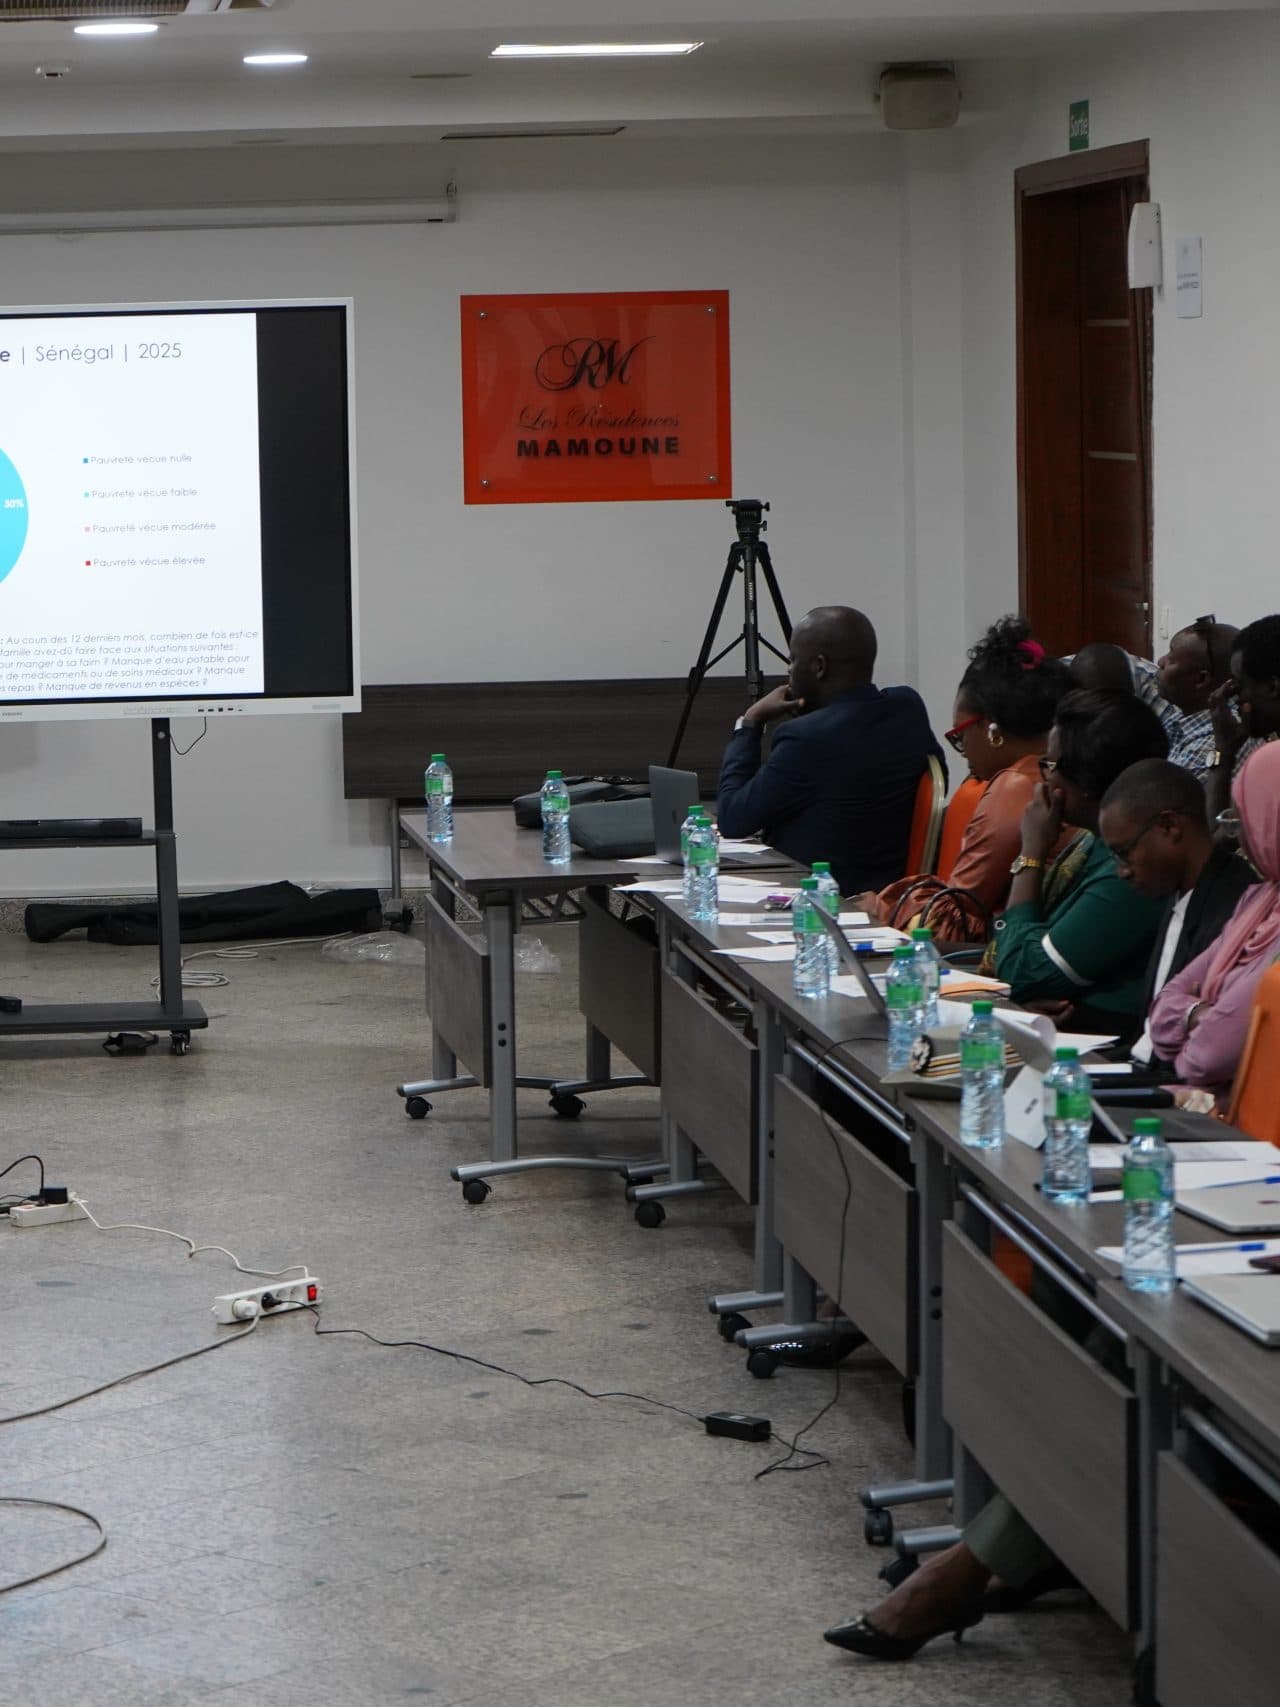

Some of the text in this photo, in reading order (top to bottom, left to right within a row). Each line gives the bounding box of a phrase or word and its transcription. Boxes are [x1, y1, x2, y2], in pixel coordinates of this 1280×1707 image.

[35, 344, 114, 364] Sénégal
[138, 343, 183, 359] 2025
[536, 335, 657, 391] RM
[517, 437, 679, 457] MAMOUNE
[7, 637, 20, 645] Au
[22, 637, 47, 645] cours
[50, 635, 67, 643] des
[71, 635, 81, 643] 12
[83, 634, 121, 643] derniers
[150, 631, 192, 640] combien
[195, 631, 208, 640] de
[211, 631, 226, 639] fois
[0, 648, 31, 657] famille
[75, 646, 96, 655] faire
[98, 646, 121, 654] face
[144, 643, 189, 652] situations
[190, 643, 233, 651] suivantes
[16, 660, 54, 669] manger
[66, 659, 77, 667] sa
[80, 657, 101, 666] faim
[111, 657, 153, 666] Manque
[187, 655, 225, 665] potable
[228, 655, 250, 664] pour
[6, 672, 20, 680] de
[105, 669, 118, 677] de
[121, 668, 143, 676] soins
[205, 667, 245, 675] Manque
[8, 684, 34, 692] repas
[45, 682, 87, 691] Manque
[89, 681, 102, 690] de
[160, 678, 200, 687] espèces
